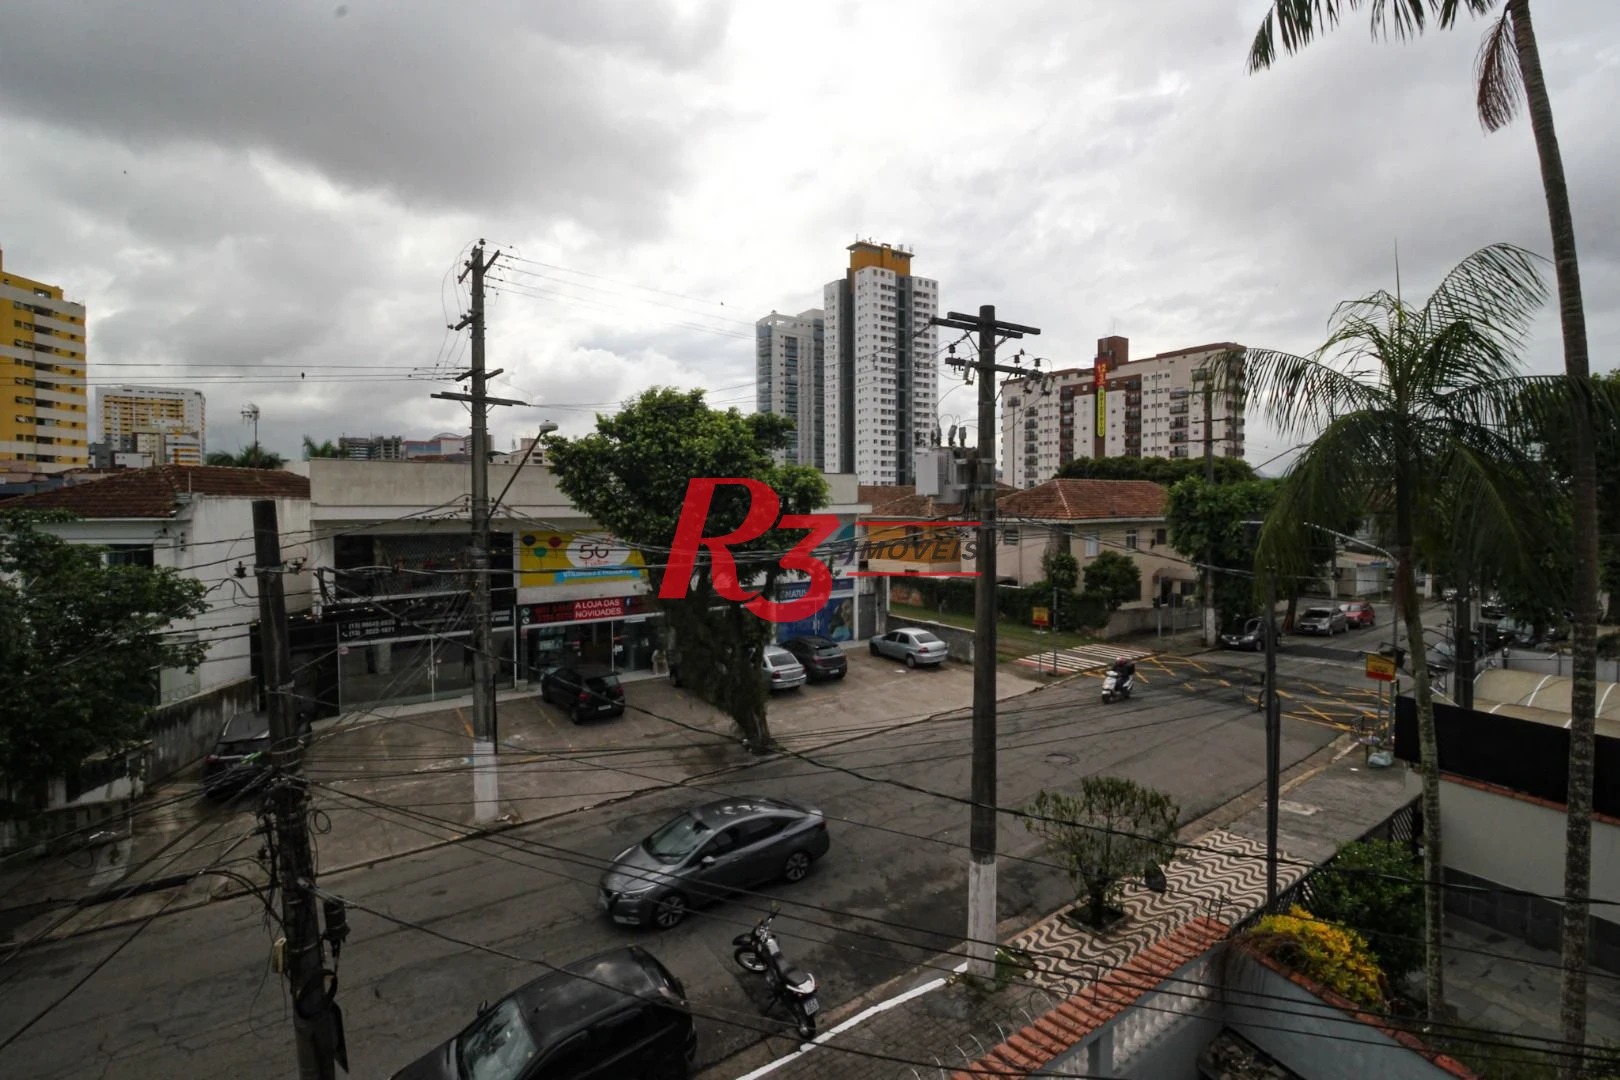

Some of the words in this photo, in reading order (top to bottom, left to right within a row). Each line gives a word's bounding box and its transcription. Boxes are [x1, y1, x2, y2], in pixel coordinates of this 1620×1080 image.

[575, 601, 582, 609] A
[582, 600, 602, 608] LOJA
[603, 599, 620, 607] DAS
